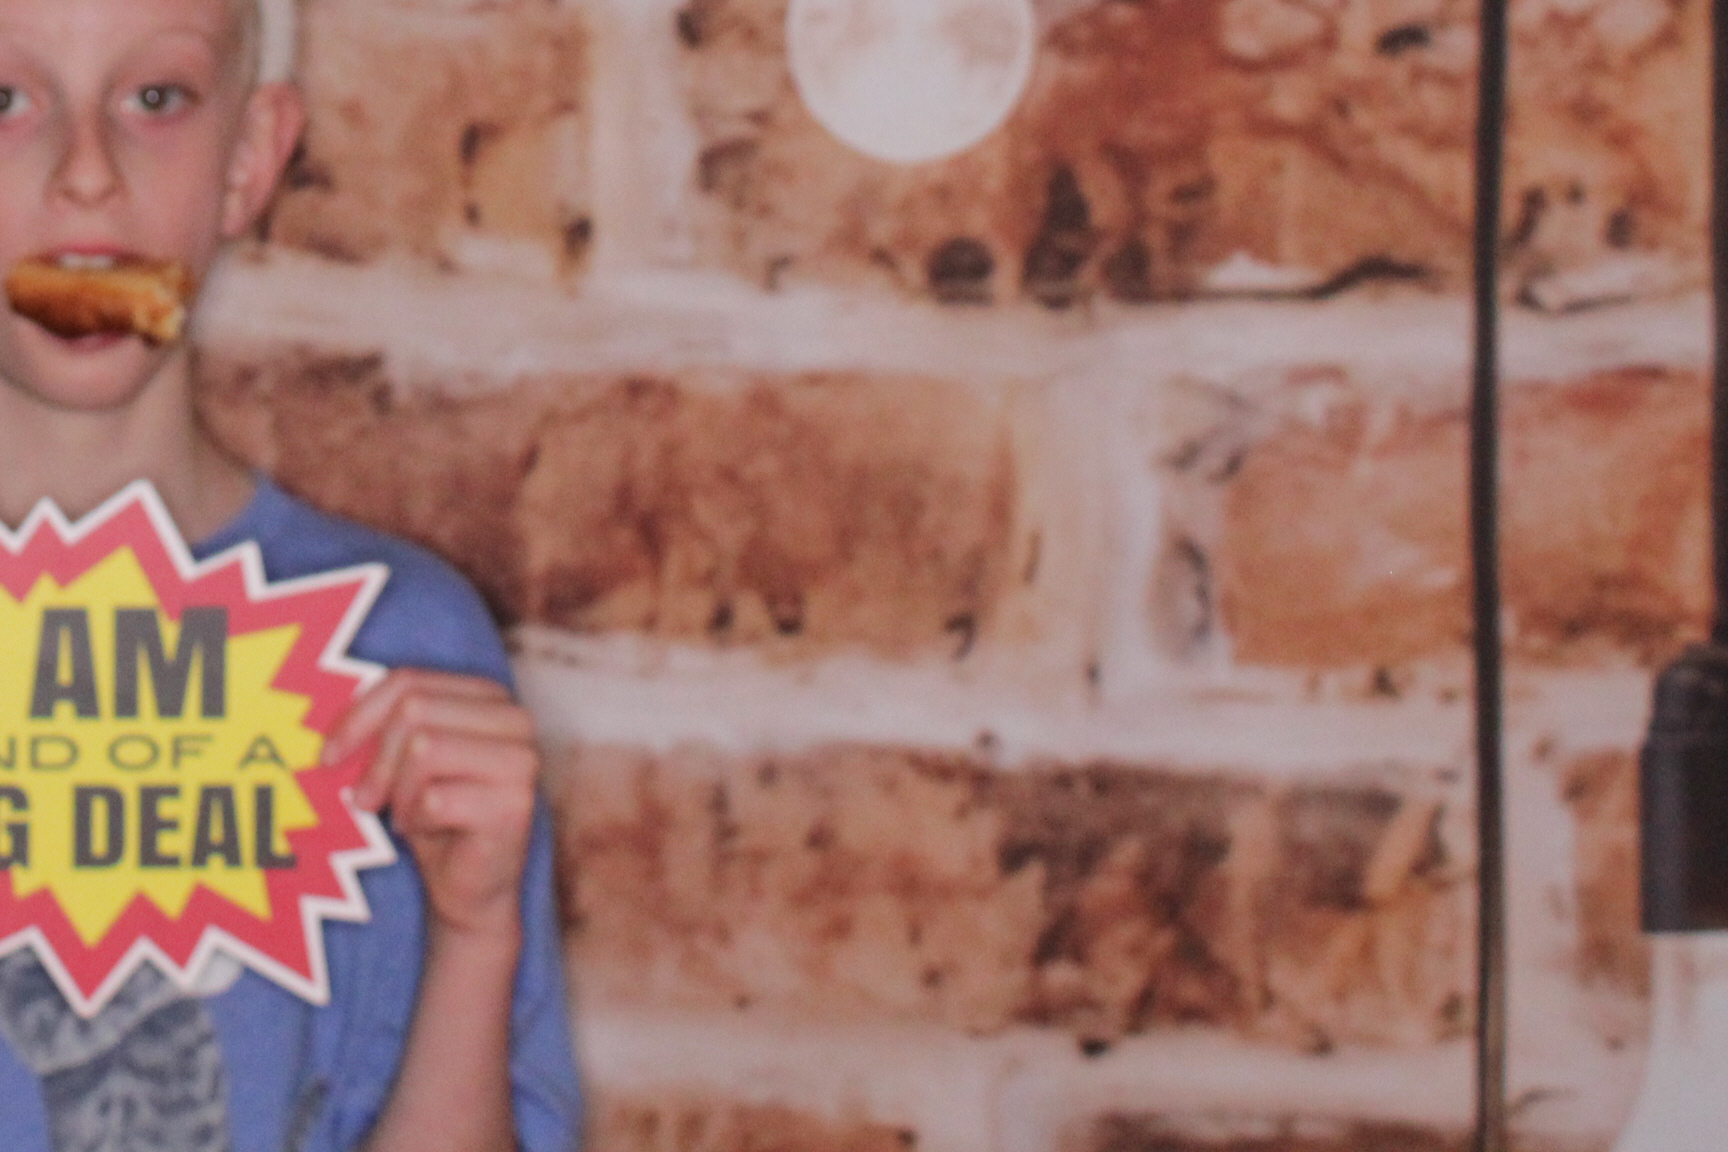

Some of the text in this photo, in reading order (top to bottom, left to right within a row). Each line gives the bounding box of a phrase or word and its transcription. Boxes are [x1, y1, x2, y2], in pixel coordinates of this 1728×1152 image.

[28, 605, 229, 719] AM
[107, 733, 215, 771] OF
[238, 733, 289, 770] A
[73, 784, 299, 871] DEAL
